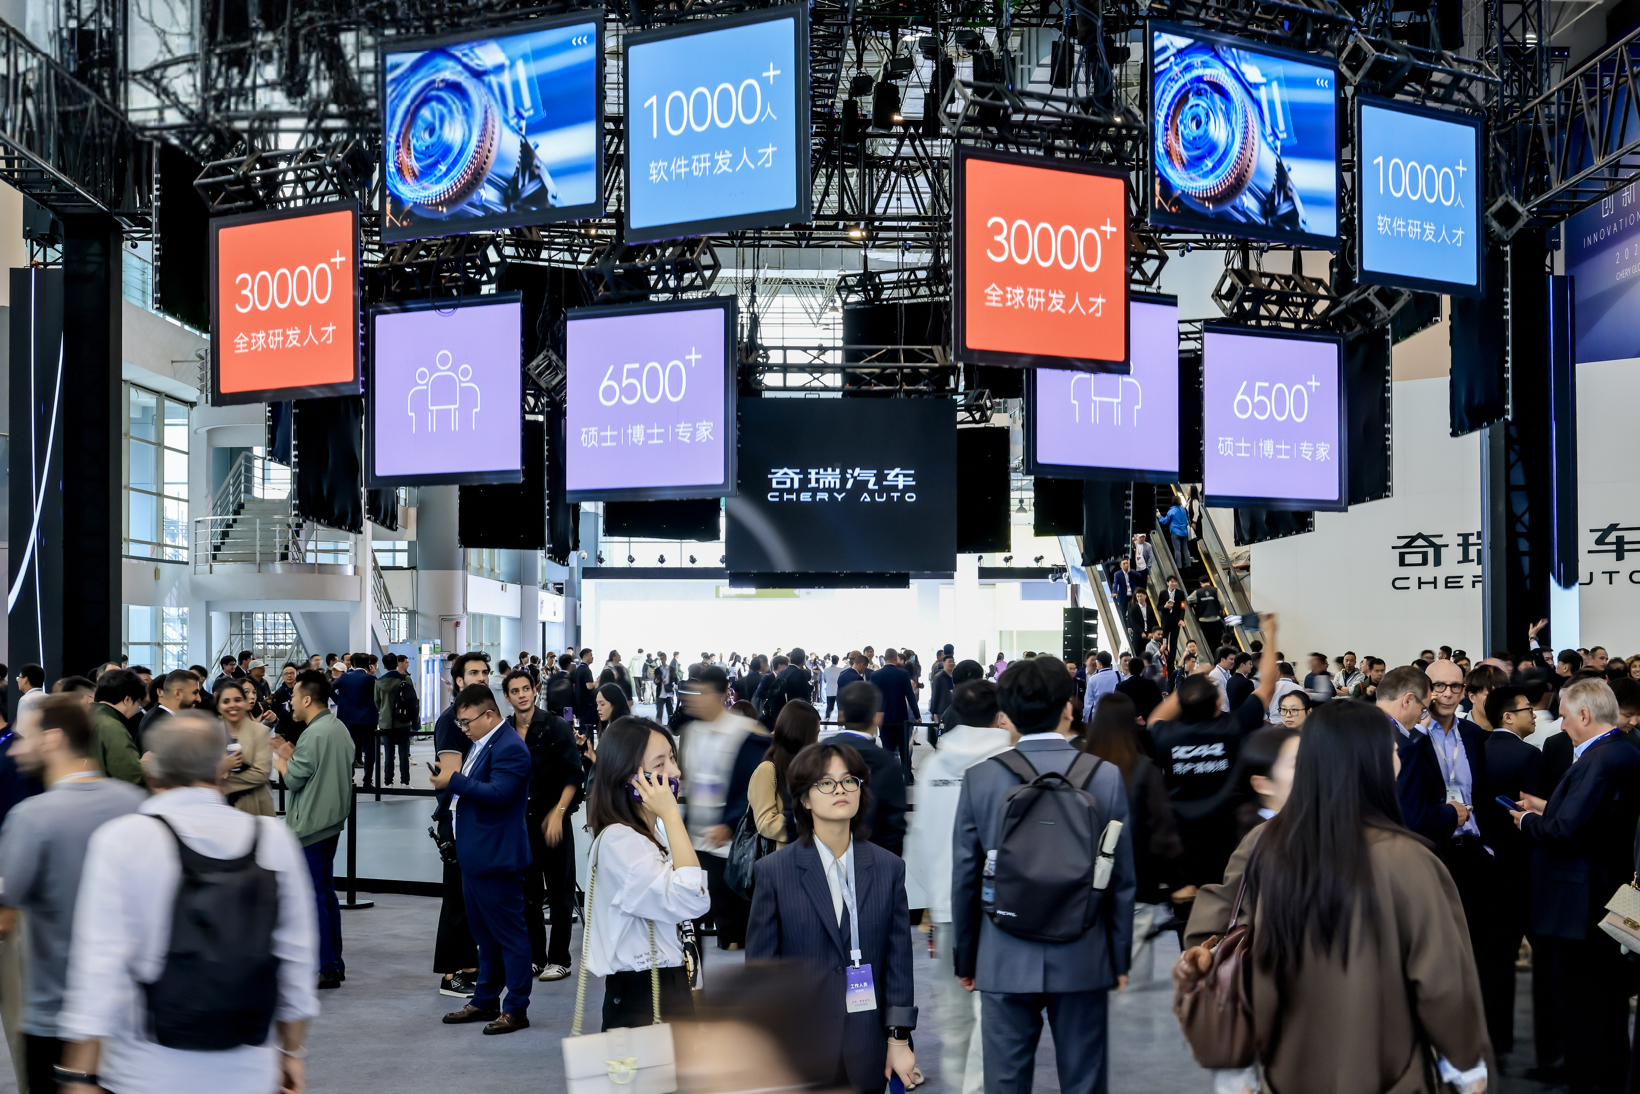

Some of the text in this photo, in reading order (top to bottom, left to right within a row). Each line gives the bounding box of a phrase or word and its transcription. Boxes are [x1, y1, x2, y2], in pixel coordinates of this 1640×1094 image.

[648, 143, 778, 184] 软件研发人才
[987, 216, 1117, 273] 30000+
[1376, 213, 1465, 247] 软件研发人才
[234, 249, 346, 314] 30000+
[984, 282, 1107, 318] 全球研发人才
[233, 322, 337, 354] 全球研发人才
[598, 346, 703, 407] 6500+
[1233, 374, 1321, 423] 6500+
[767, 467, 916, 489] 奇瑞汽车
[767, 492, 917, 502] CHERY AUTO
